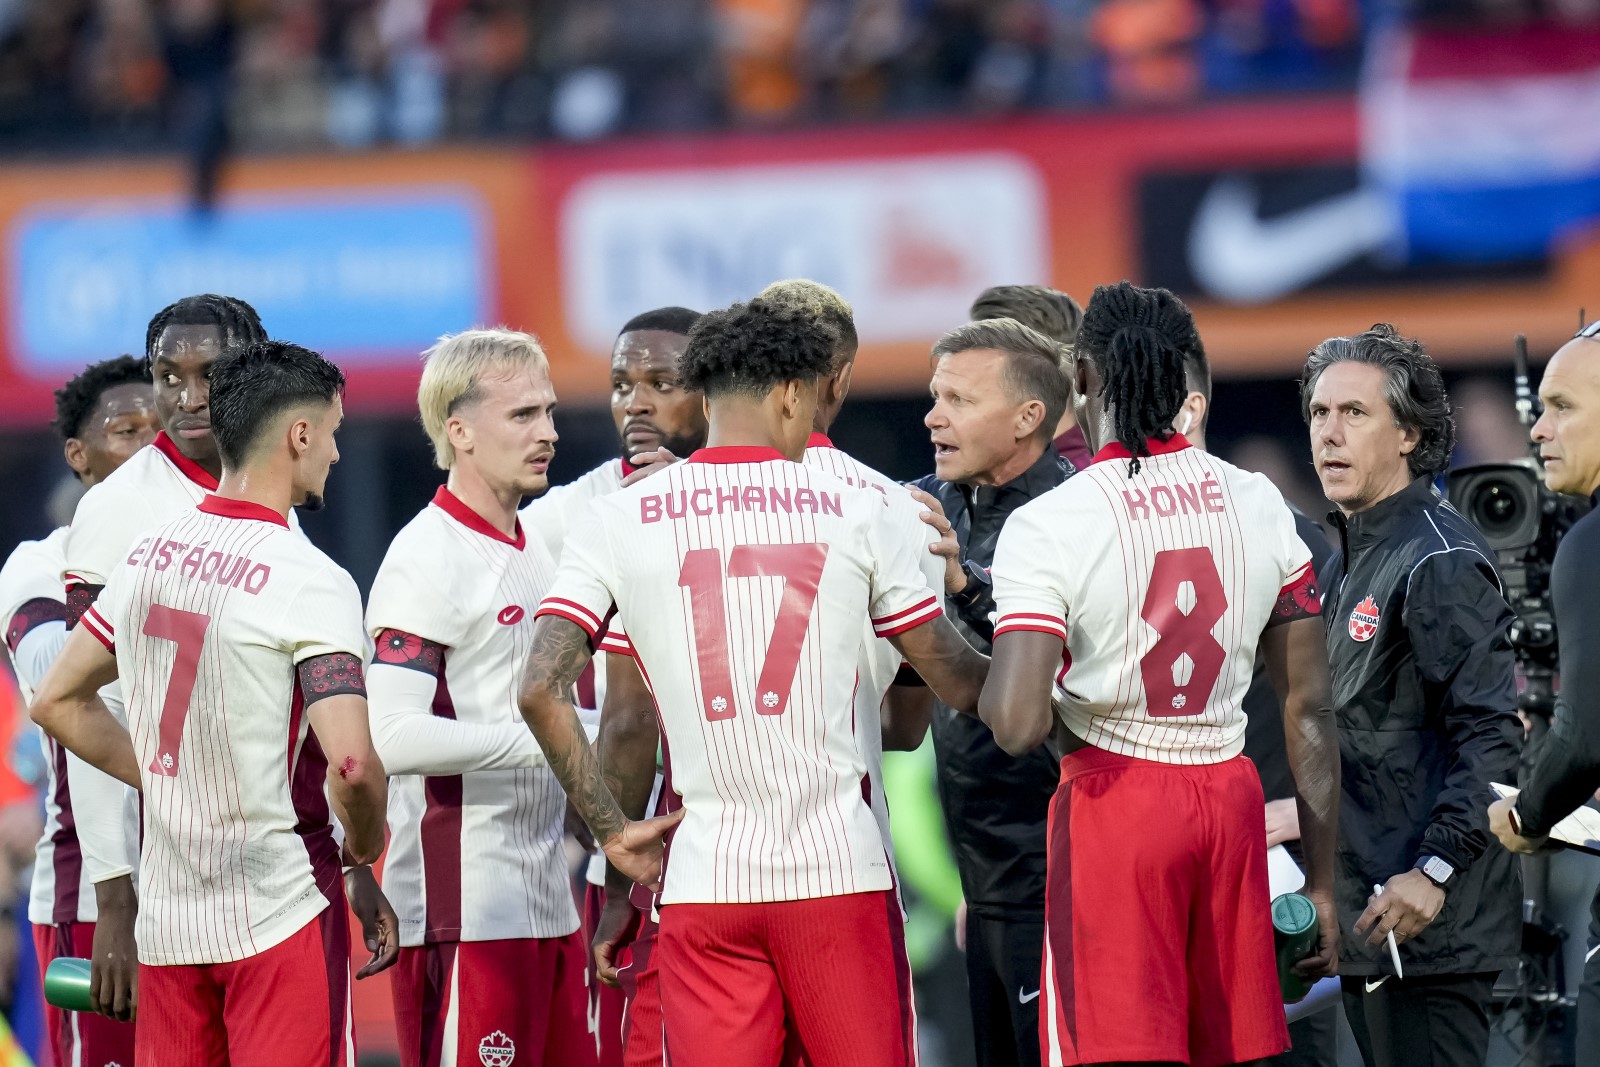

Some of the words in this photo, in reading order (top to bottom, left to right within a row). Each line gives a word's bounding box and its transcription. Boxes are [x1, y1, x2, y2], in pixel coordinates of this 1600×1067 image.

[640, 485, 844, 525] BUCHANAN
[1121, 471, 1225, 521] KONÉ
[677, 542, 830, 722] 17
[1140, 546, 1229, 717] 8
[1351, 612, 1378, 625] CANADA
[142, 603, 212, 777] 7
[480, 1047, 514, 1055] CANADA
